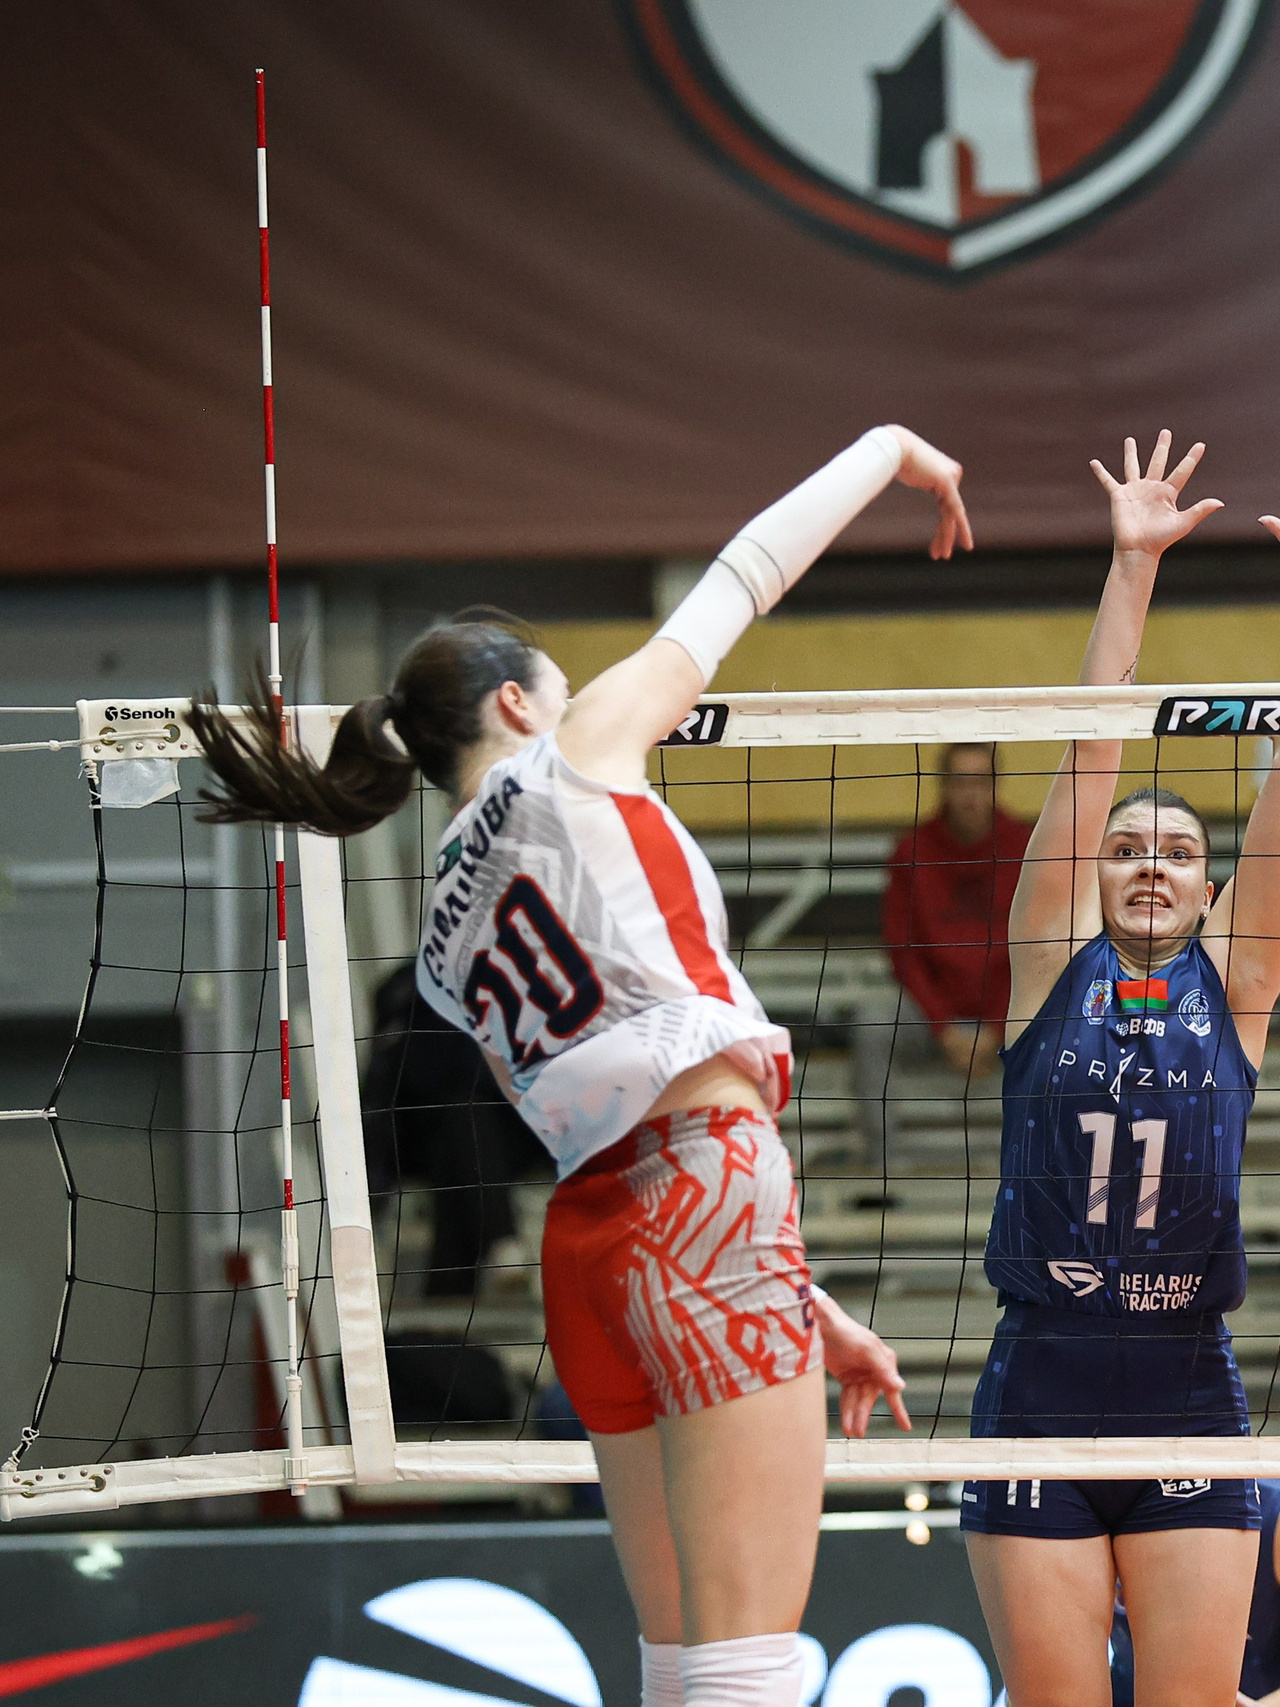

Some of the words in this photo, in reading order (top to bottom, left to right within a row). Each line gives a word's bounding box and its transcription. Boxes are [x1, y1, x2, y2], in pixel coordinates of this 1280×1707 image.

[120, 707, 175, 720] Senoh
[659, 708, 716, 741] RI
[463, 873, 605, 1071] 20
[1077, 1110, 1169, 1230] 11
[1119, 1290, 1195, 1312] TRACTOR
